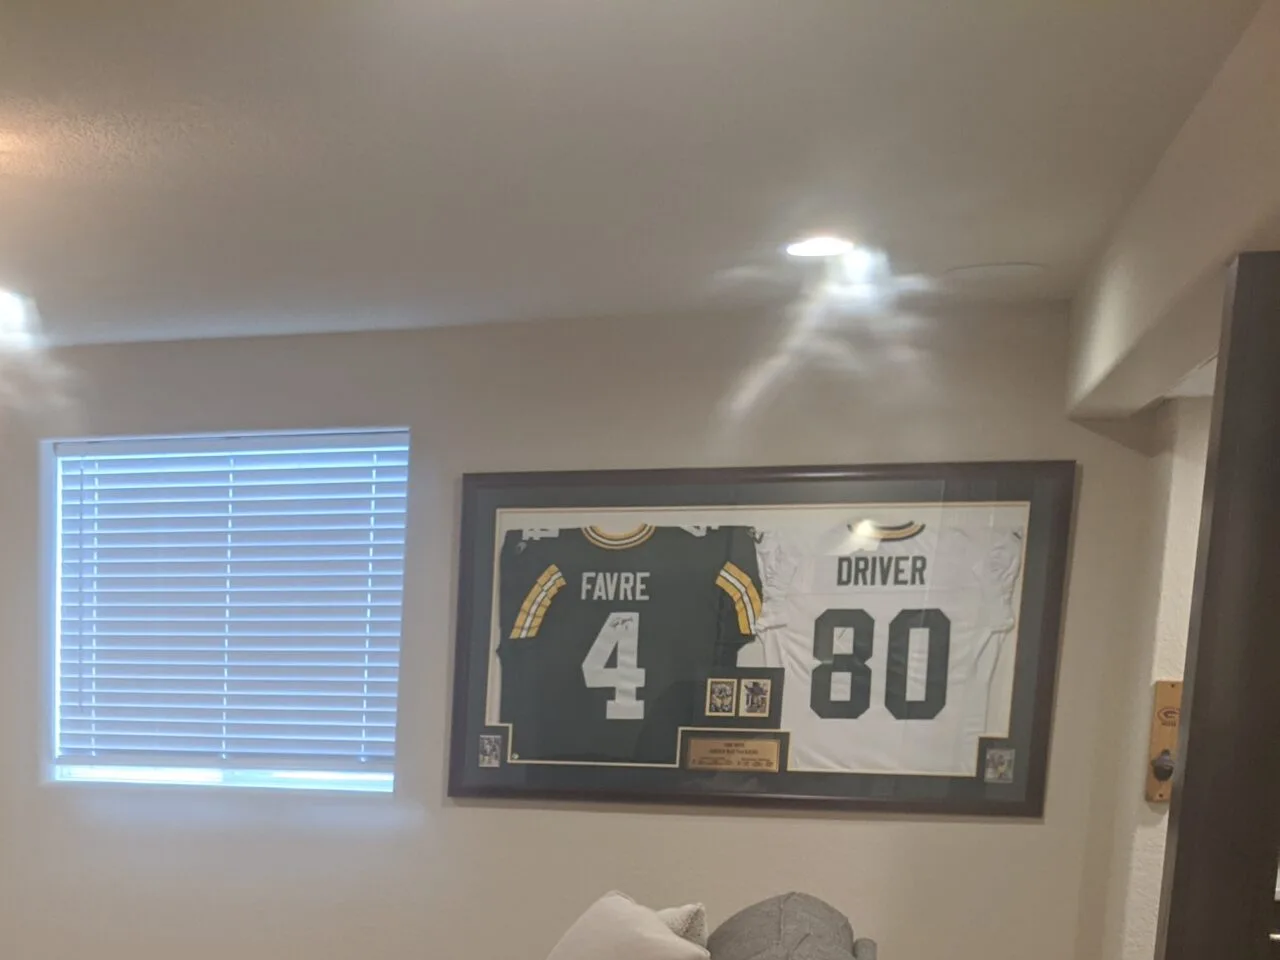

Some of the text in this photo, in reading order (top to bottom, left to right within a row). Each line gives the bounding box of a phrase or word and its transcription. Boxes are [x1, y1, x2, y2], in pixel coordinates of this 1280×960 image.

[581, 571, 651, 601] FAVRE
[836, 555, 927, 586] DRIVER
[582, 612, 646, 719] 4
[809, 608, 951, 720] 80
